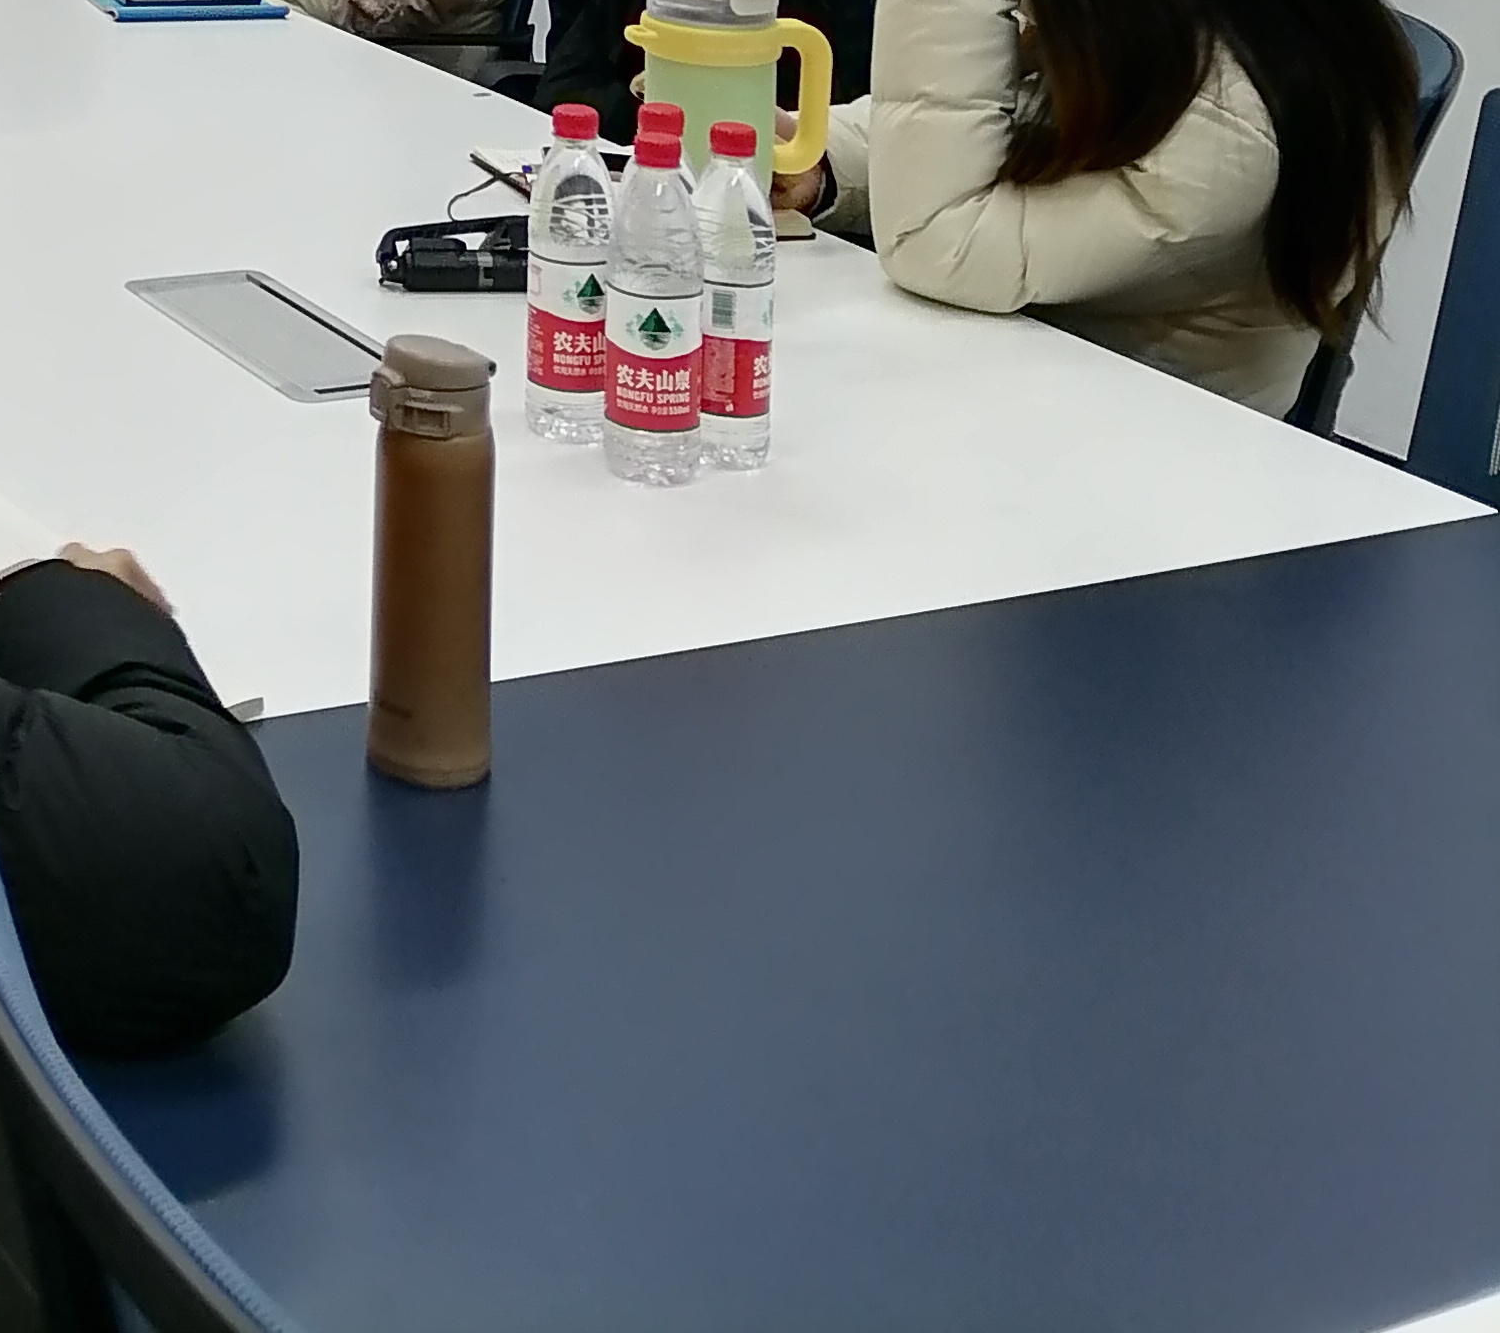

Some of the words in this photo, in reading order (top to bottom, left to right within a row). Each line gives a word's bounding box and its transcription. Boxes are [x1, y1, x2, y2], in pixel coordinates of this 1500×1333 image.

[616, 364, 690, 391] 农夫山泉
[616, 386, 654, 403] NONGFU
[657, 392, 690, 404] SPRING
